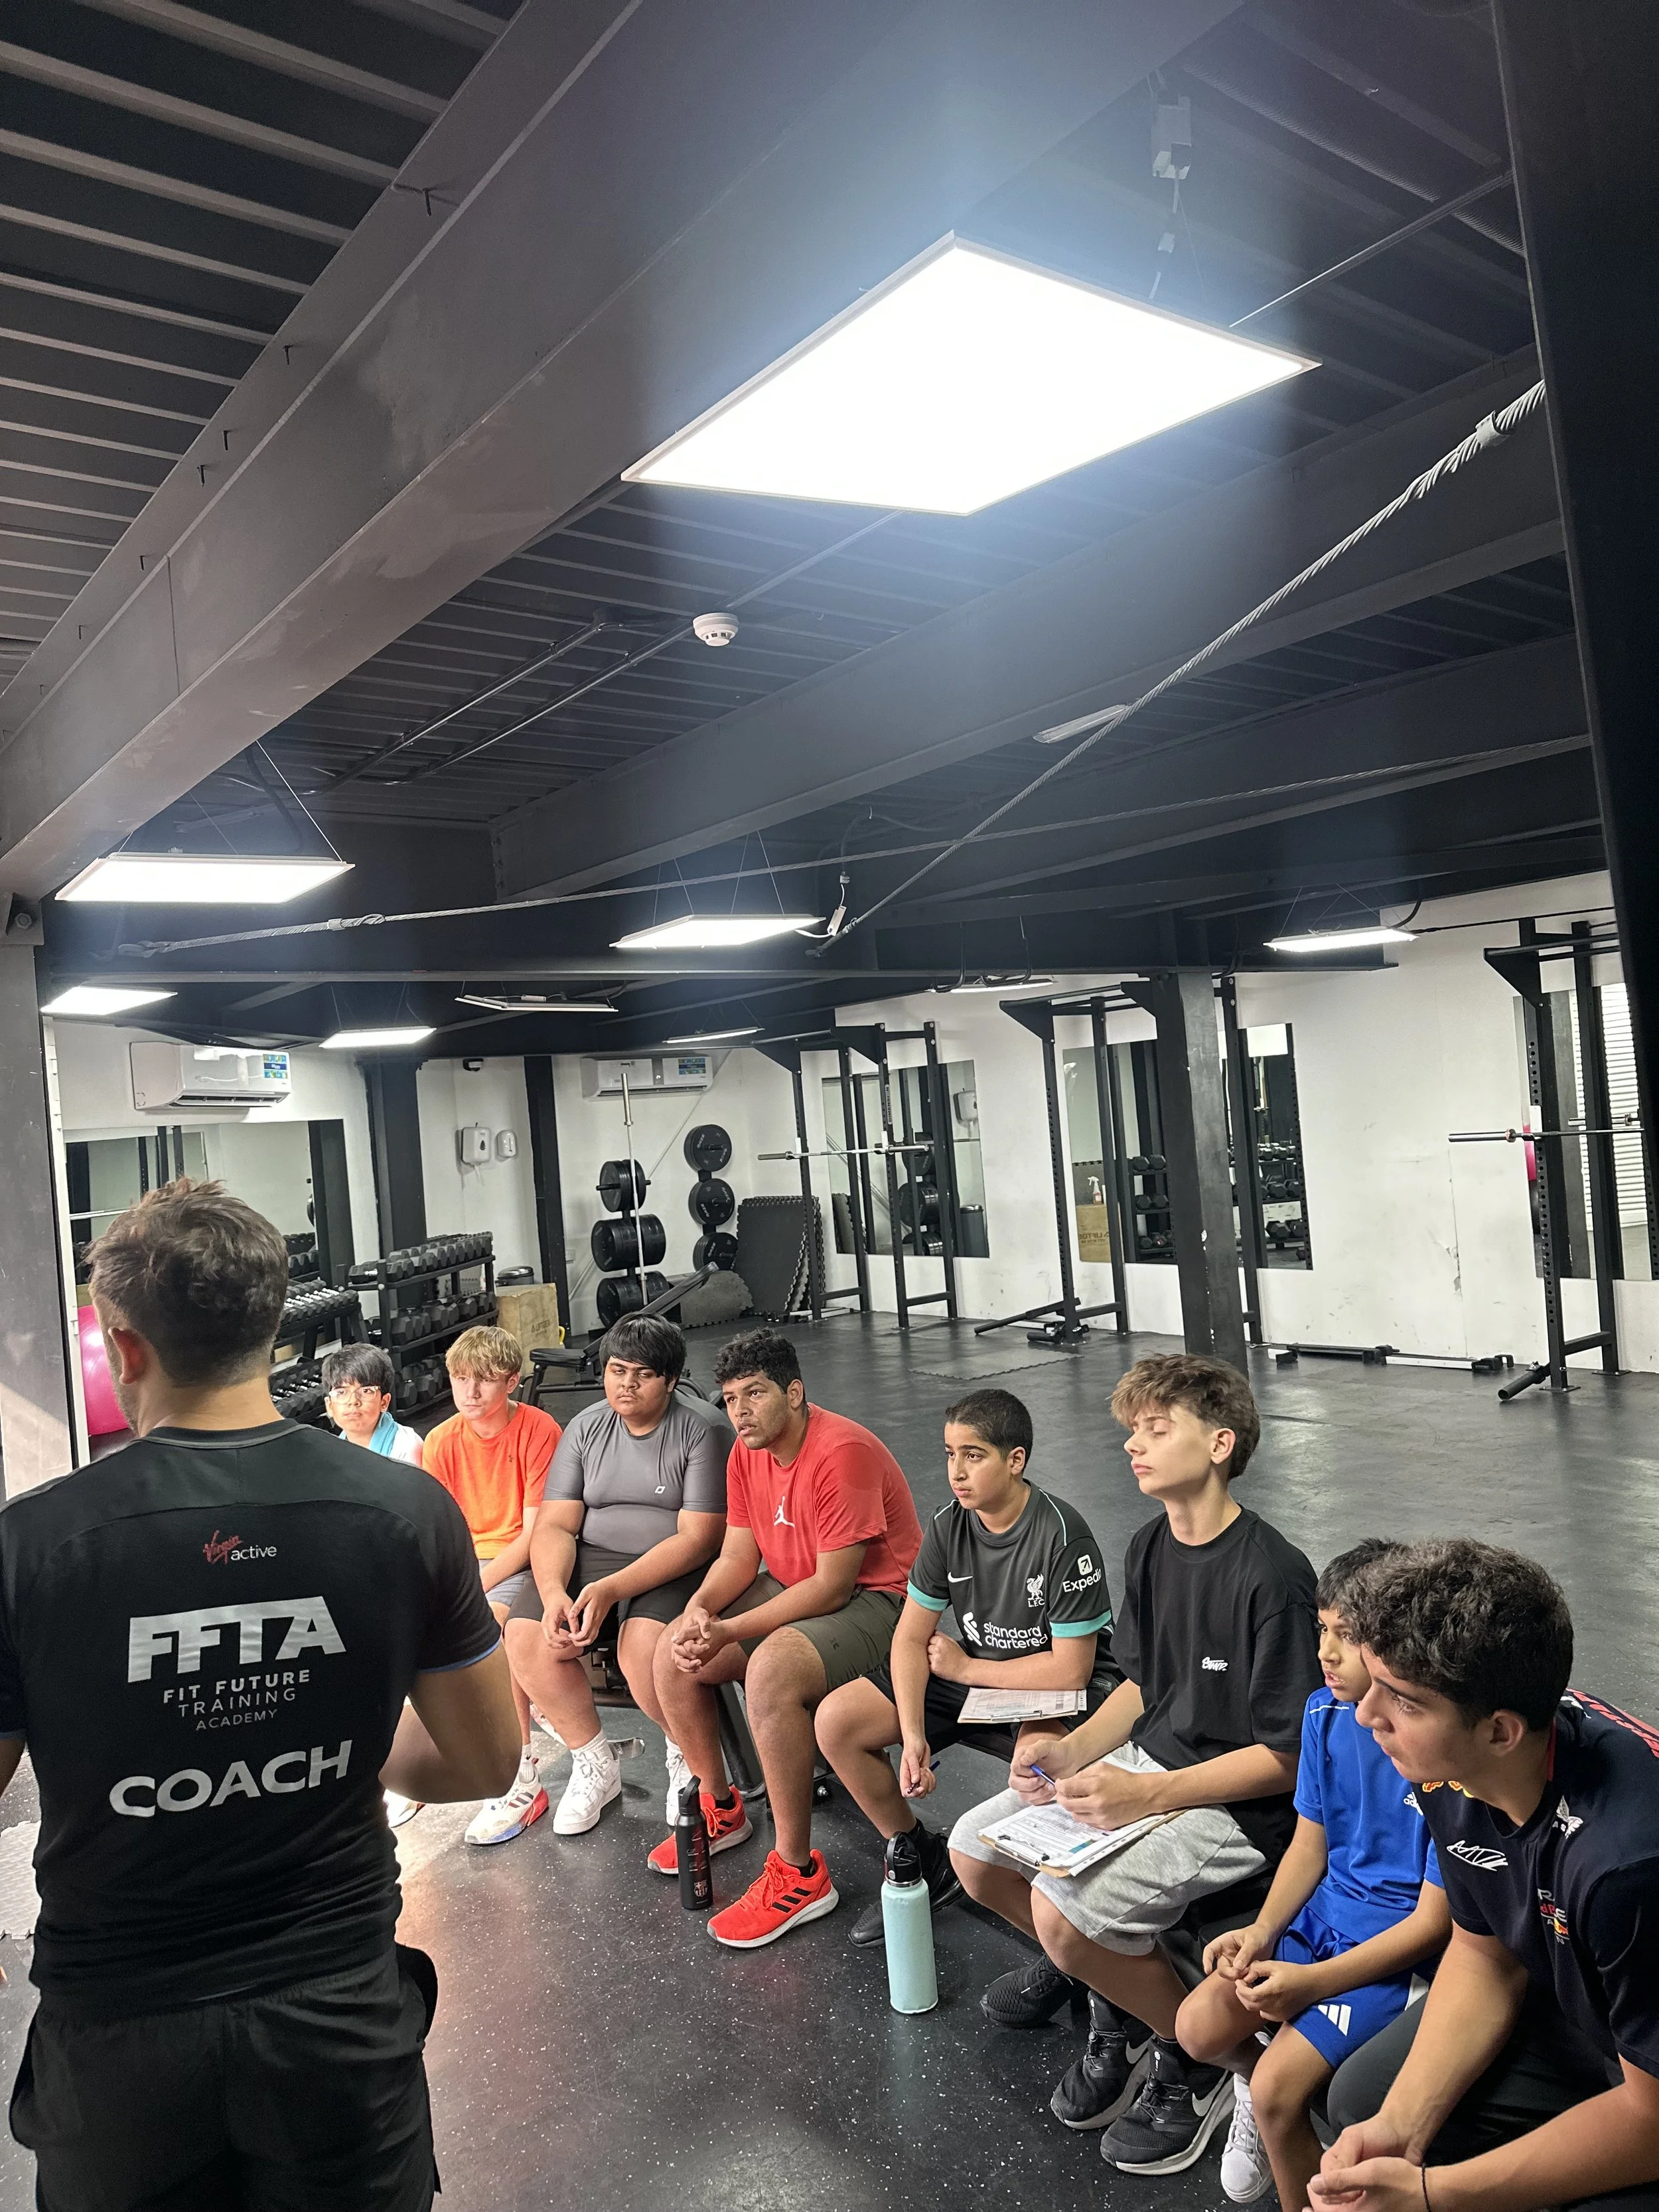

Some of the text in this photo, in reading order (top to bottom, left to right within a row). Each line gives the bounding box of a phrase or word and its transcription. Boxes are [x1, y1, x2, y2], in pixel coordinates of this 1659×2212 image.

[231, 1544, 277, 1560] active
[128, 1595, 346, 1682] FFTA
[983, 1621, 1042, 1639] standard
[985, 1634, 1048, 1649] chartered
[163, 1669, 310, 1704] FIT FUTURE
[179, 1688, 296, 1717] TRAINING
[196, 1709, 278, 1731] ACADEMY
[109, 1739, 352, 1818] COACH
